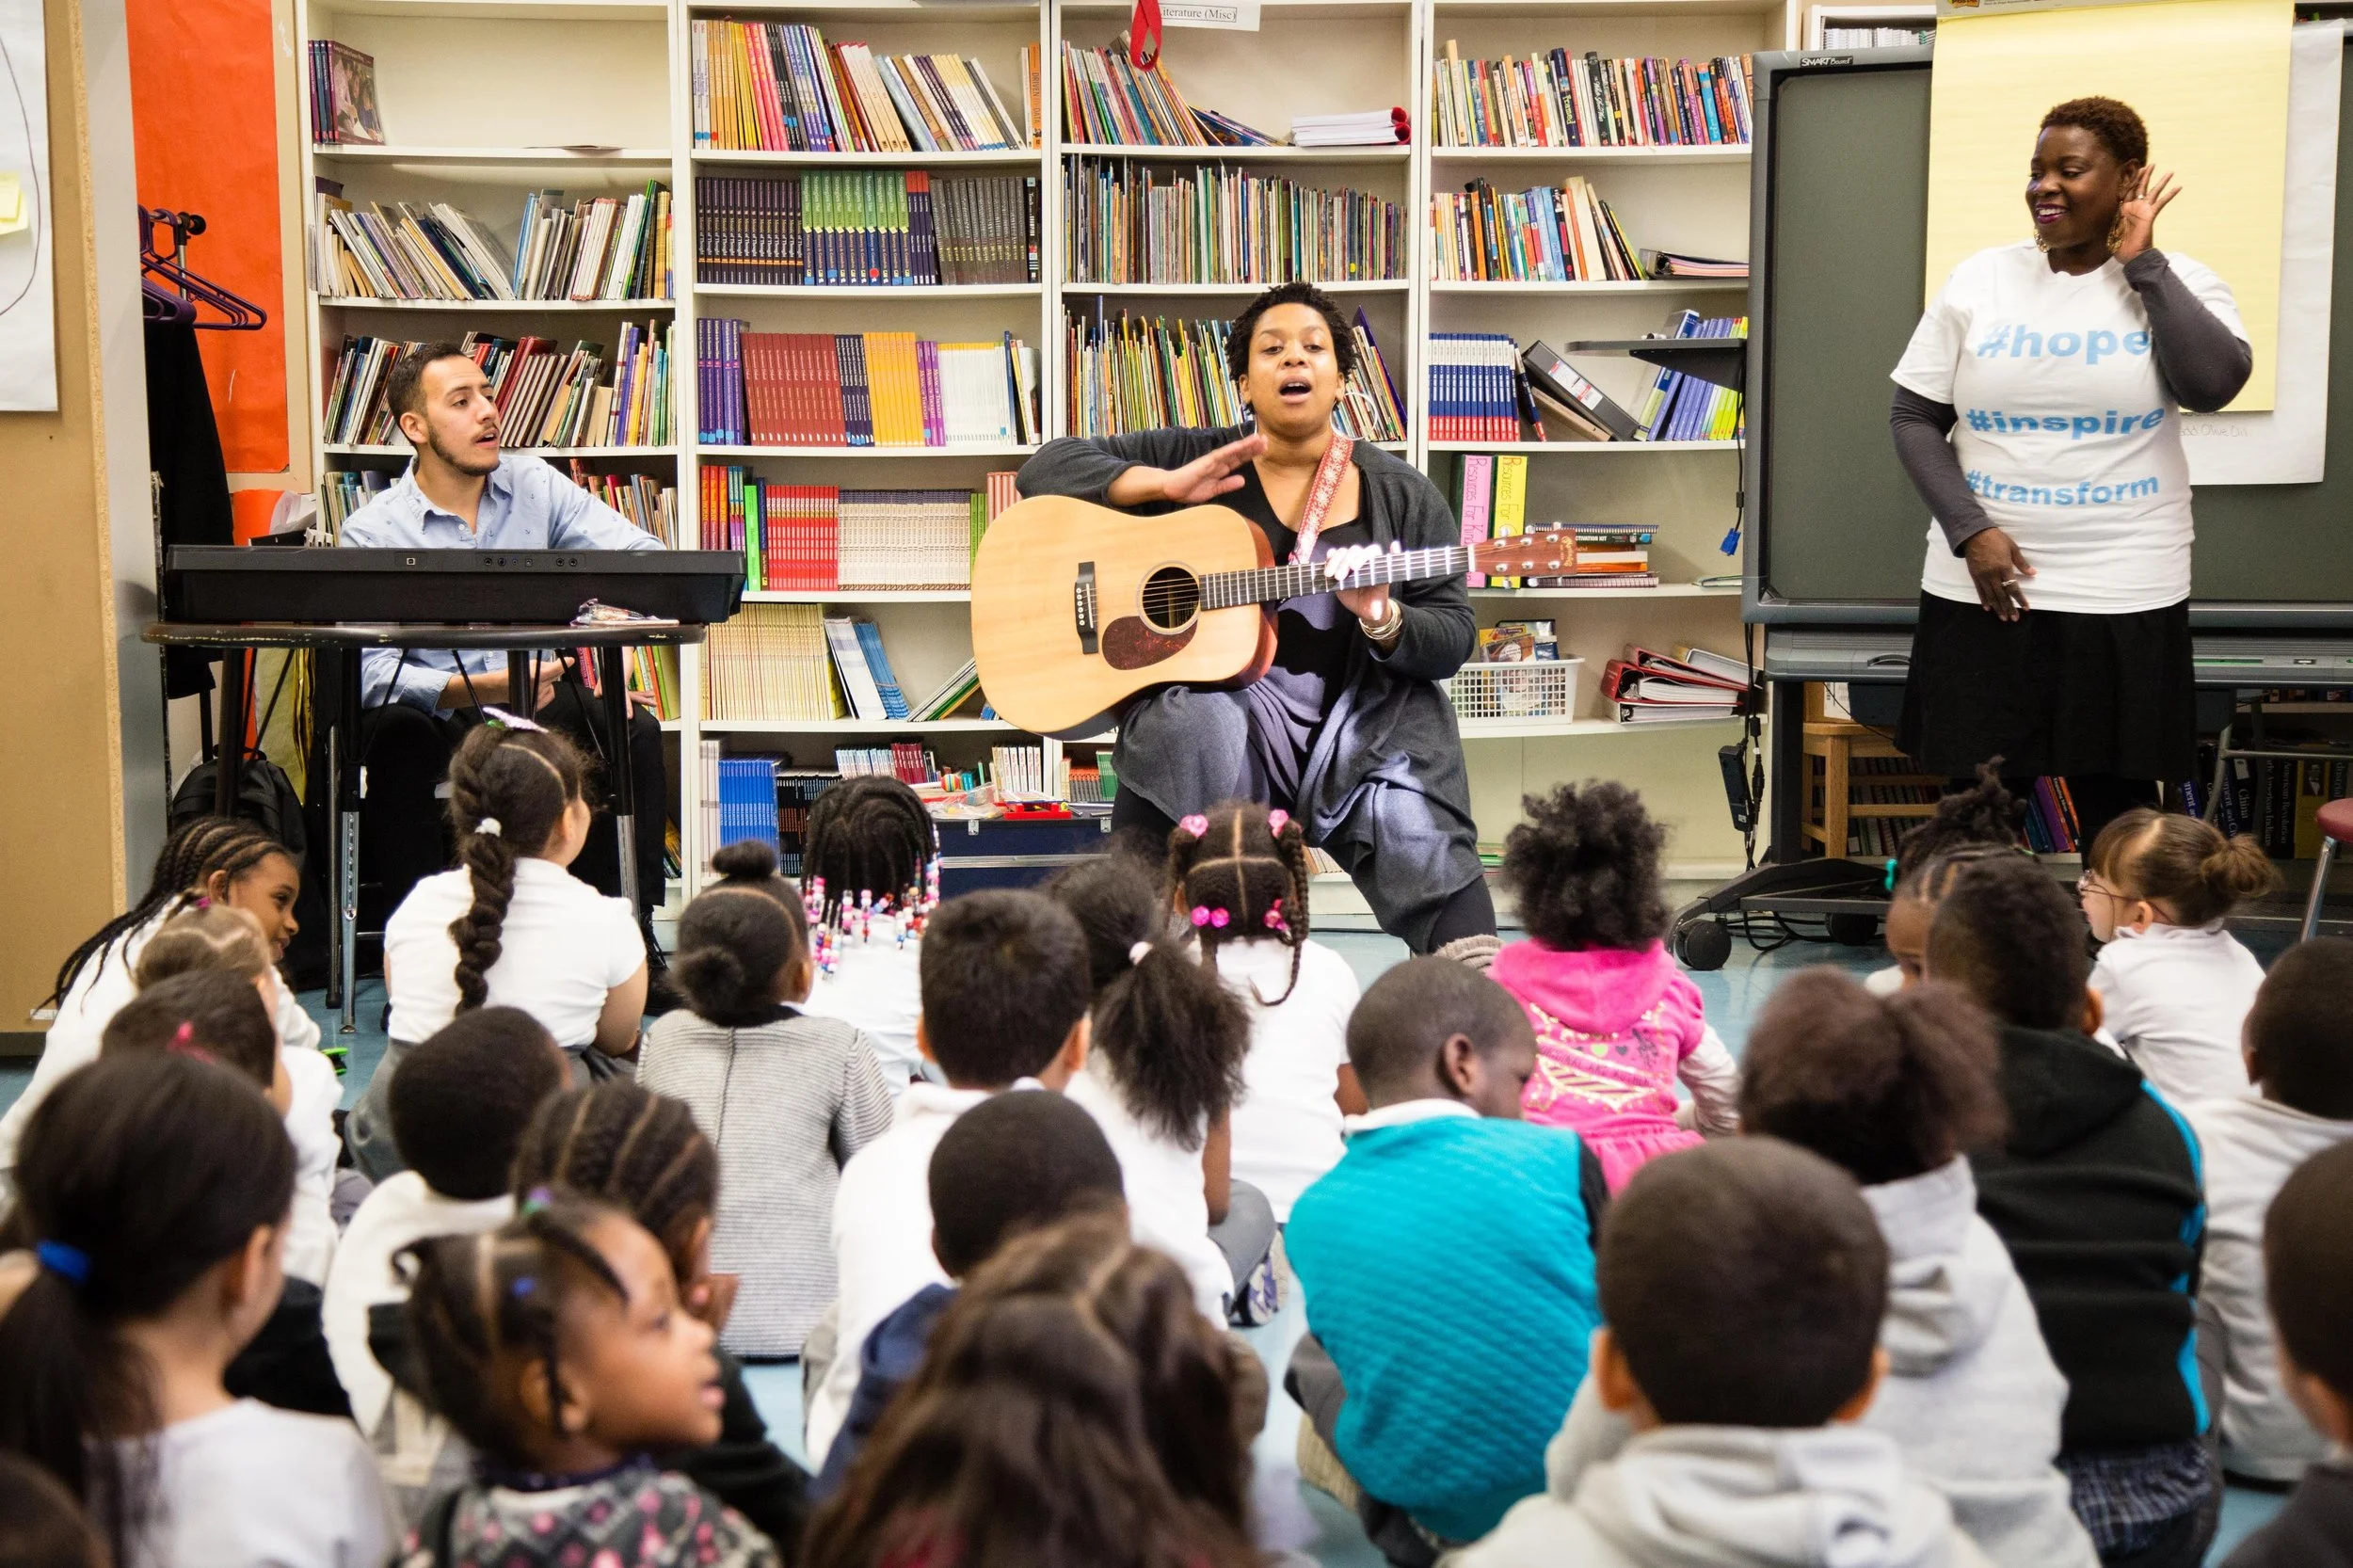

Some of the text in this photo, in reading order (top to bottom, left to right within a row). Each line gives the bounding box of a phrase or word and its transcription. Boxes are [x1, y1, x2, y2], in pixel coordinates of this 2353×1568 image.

[1163, 7, 1236, 20] iterature (Misc)
[1802, 58, 1831, 66] SMART
[1562, 95, 1575, 125] Framed
[1977, 324, 2151, 365] #hope
[1965, 408, 2165, 440] #inspire
[1466, 458, 1487, 501] Resources
[1500, 457, 1522, 520] Resources For
[1966, 469, 2160, 506] #transform
[1466, 505, 1484, 521] For
[2238, 788, 2251, 819] China
[2280, 762, 2292, 844] American Revolution
